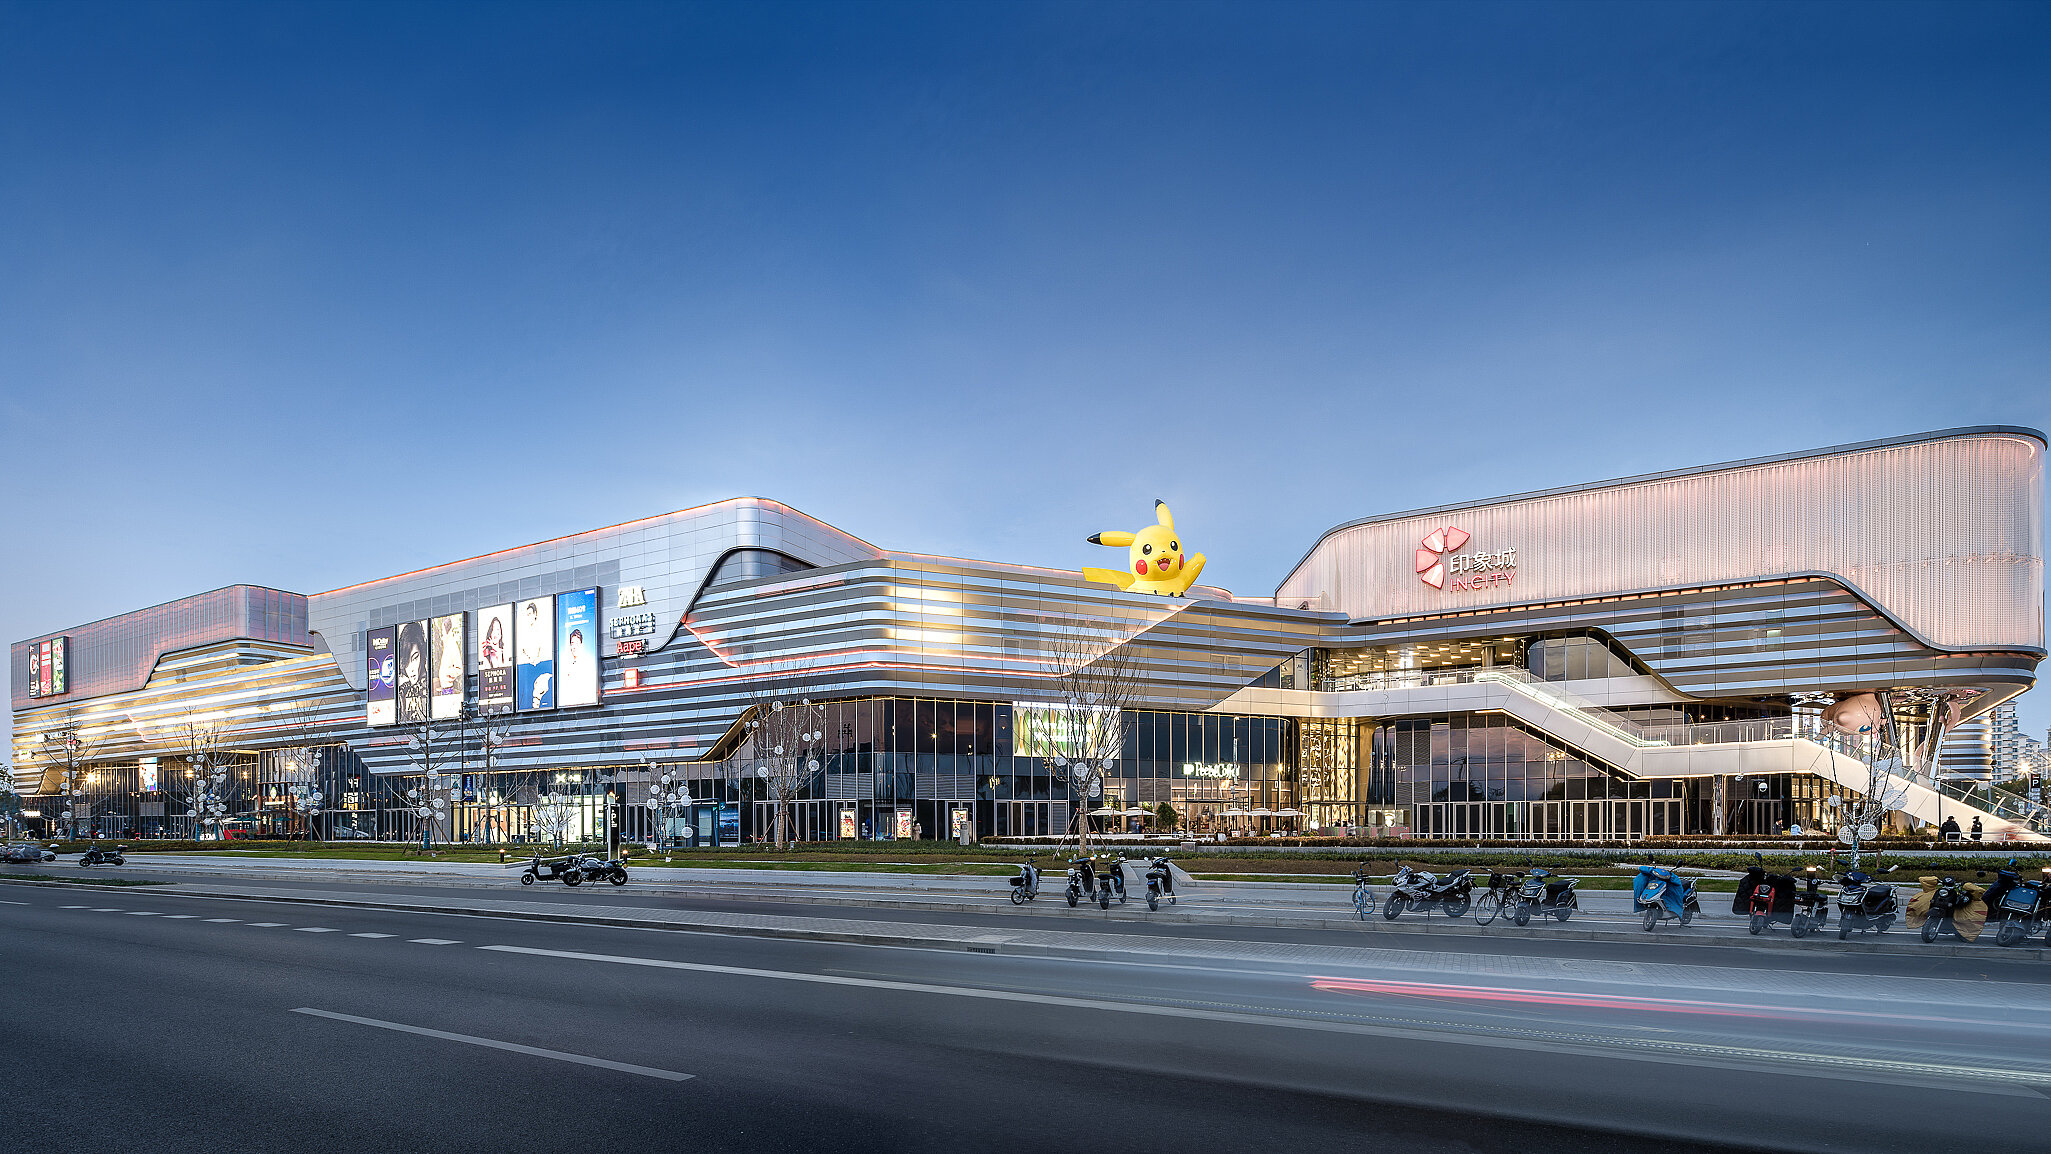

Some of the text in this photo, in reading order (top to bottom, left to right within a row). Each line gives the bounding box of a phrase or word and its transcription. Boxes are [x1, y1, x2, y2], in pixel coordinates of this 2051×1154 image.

[1450, 547, 1517, 574] 印象城
[1450, 570, 1517, 592] INCITY
[616, 641, 642, 655] Aape
